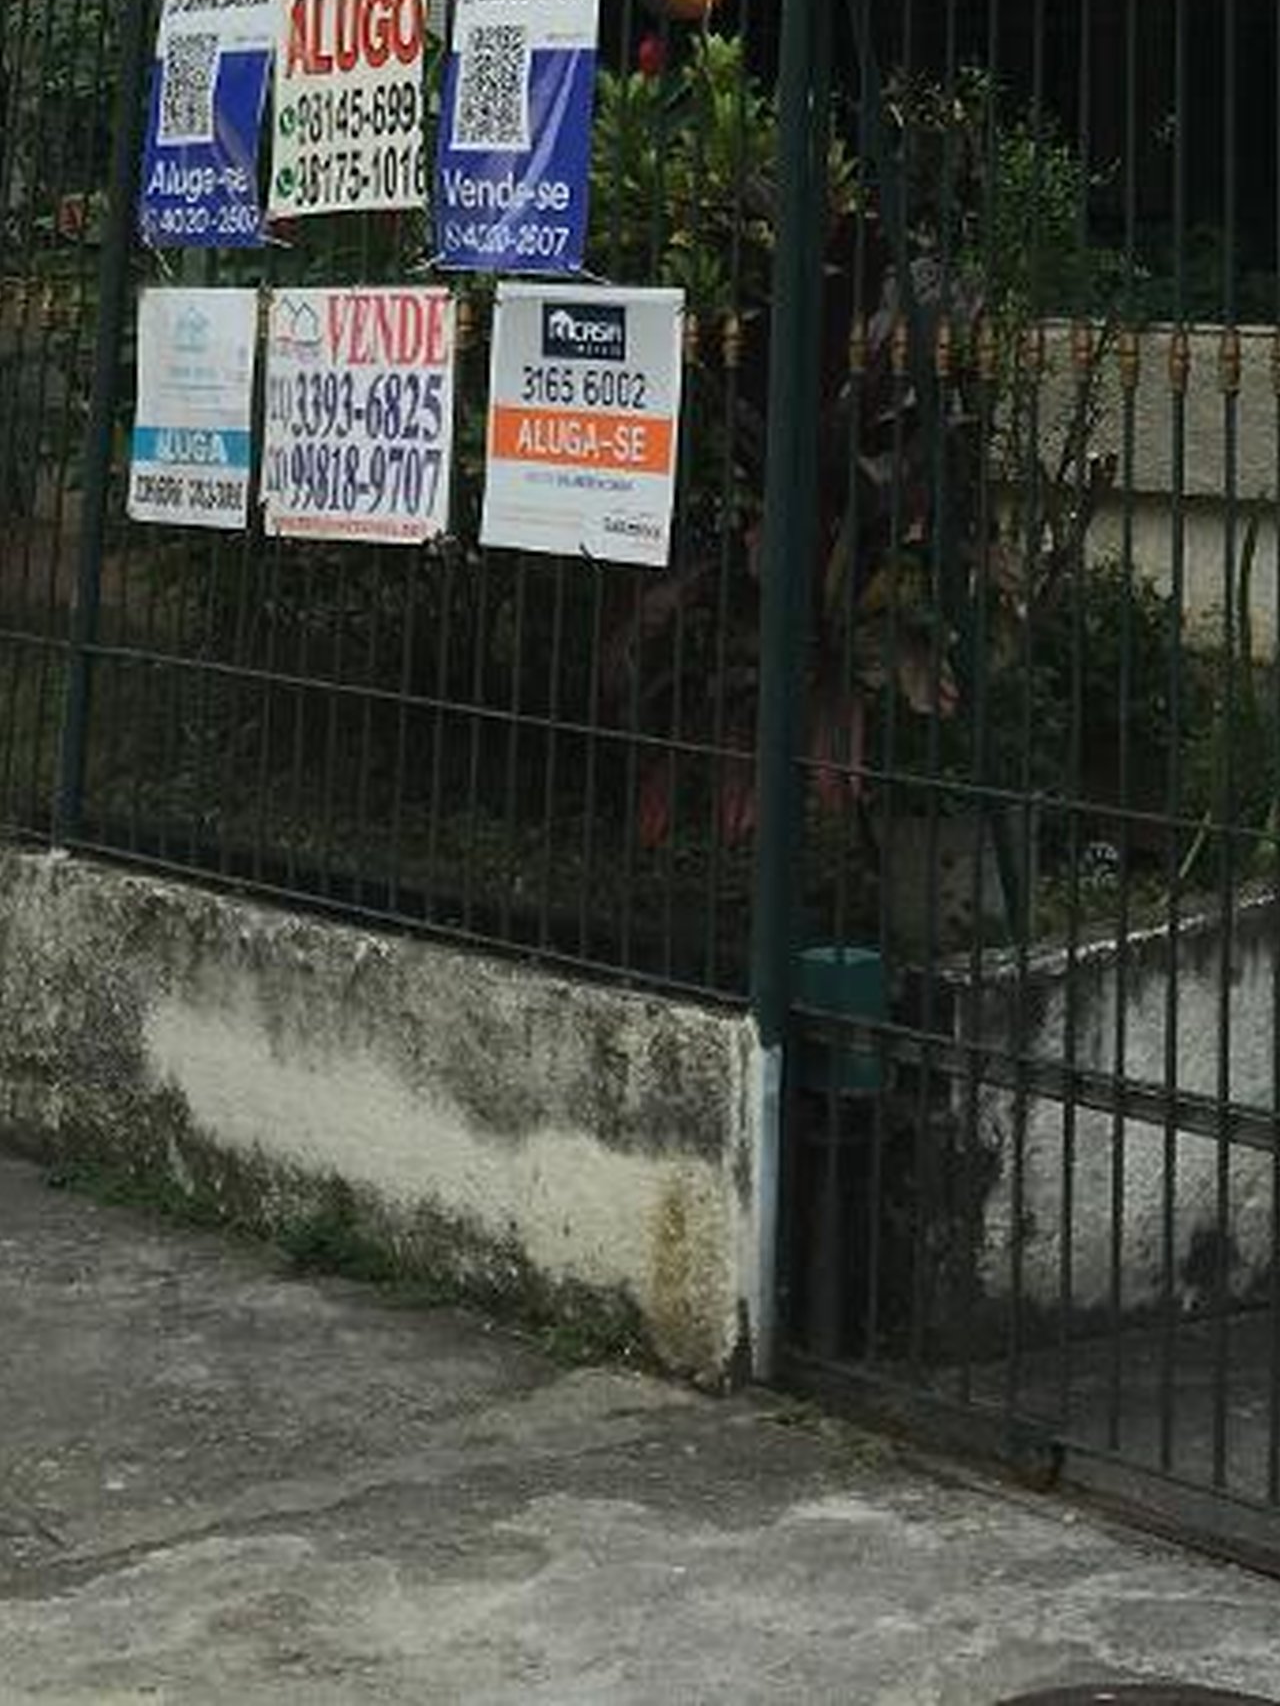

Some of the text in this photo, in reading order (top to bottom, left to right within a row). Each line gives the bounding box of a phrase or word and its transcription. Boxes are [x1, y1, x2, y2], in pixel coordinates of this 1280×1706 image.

[442, 168, 570, 210] Vende-se
[328, 295, 447, 366] VENDE
[291, 372, 443, 442] 3393-6825
[583, 370, 646, 409] 6002
[518, 418, 646, 462] ALUGA-SE
[290, 443, 442, 517] 99818-9707
